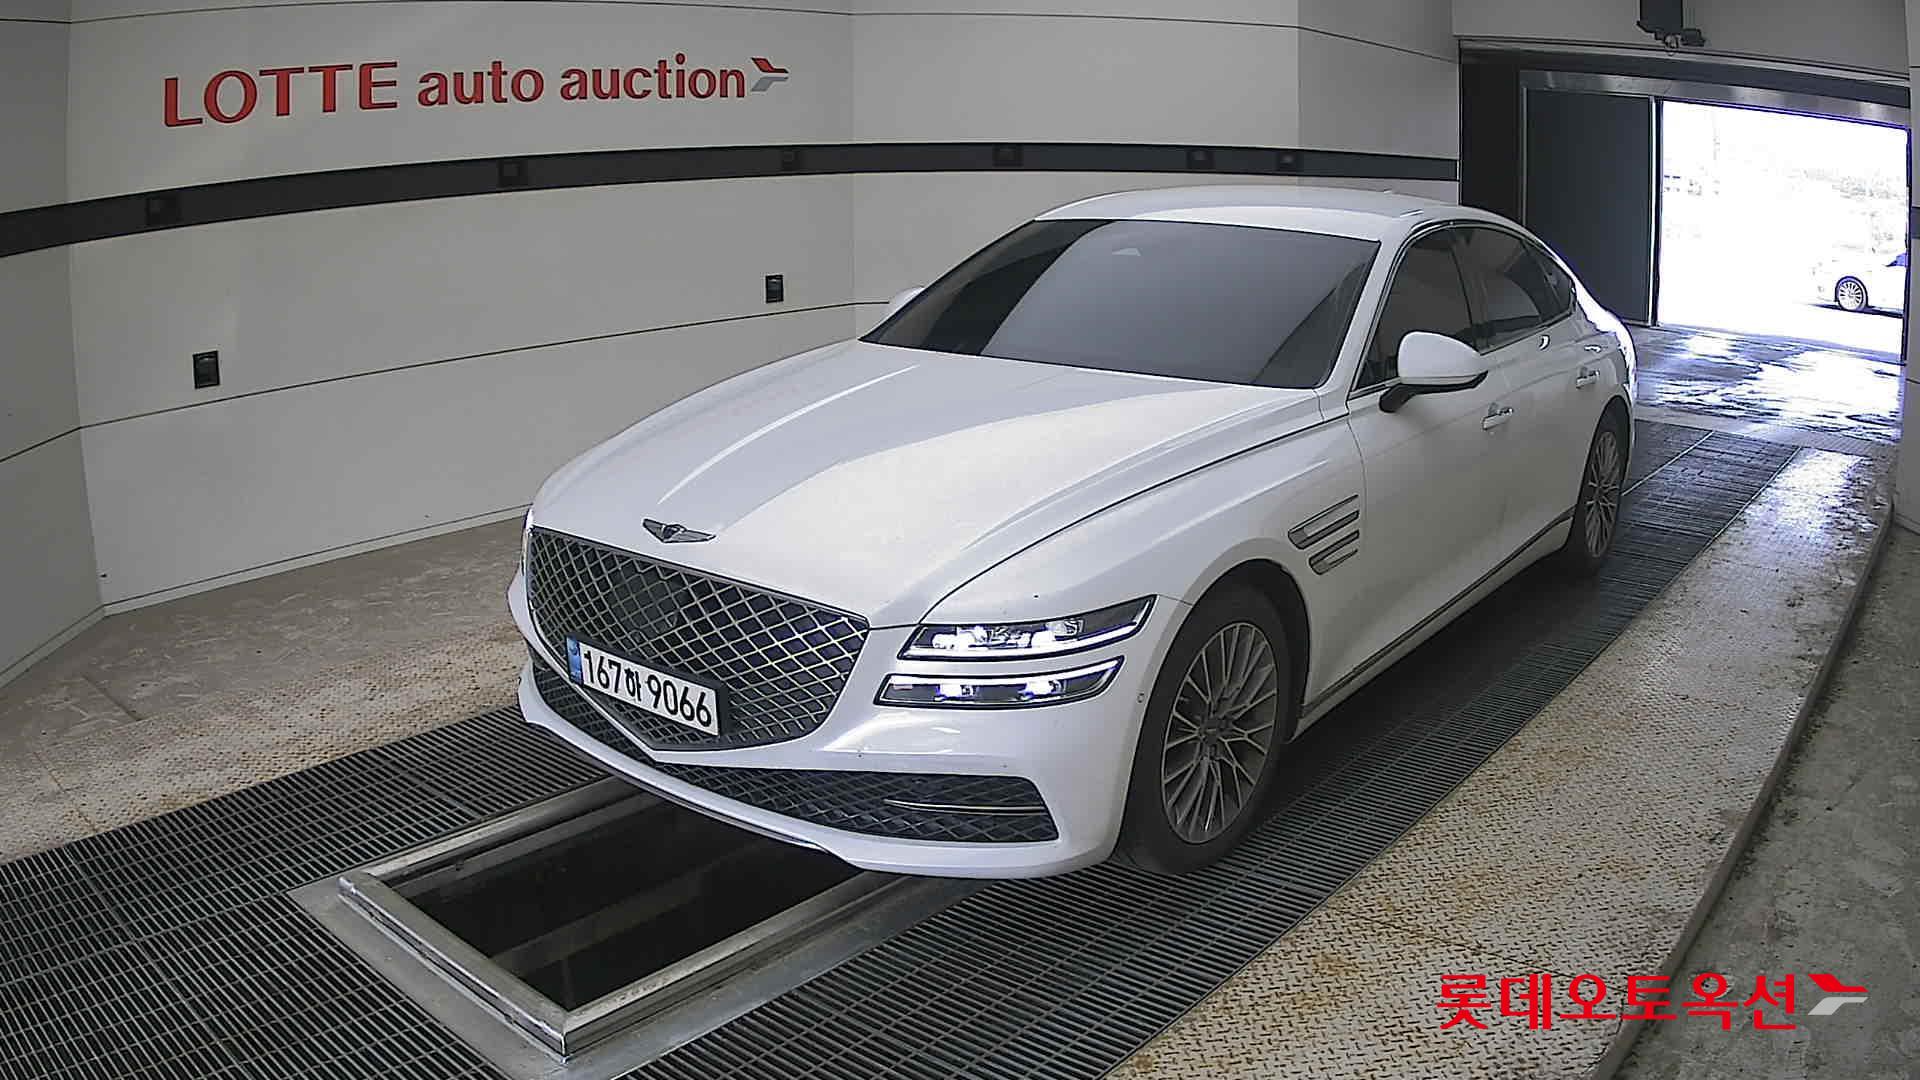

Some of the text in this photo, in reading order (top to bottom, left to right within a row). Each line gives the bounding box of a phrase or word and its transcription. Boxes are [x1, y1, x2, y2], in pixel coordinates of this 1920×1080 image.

[163, 53, 746, 127] LOTTE auto auction
[645, 674, 712, 728] 9066
